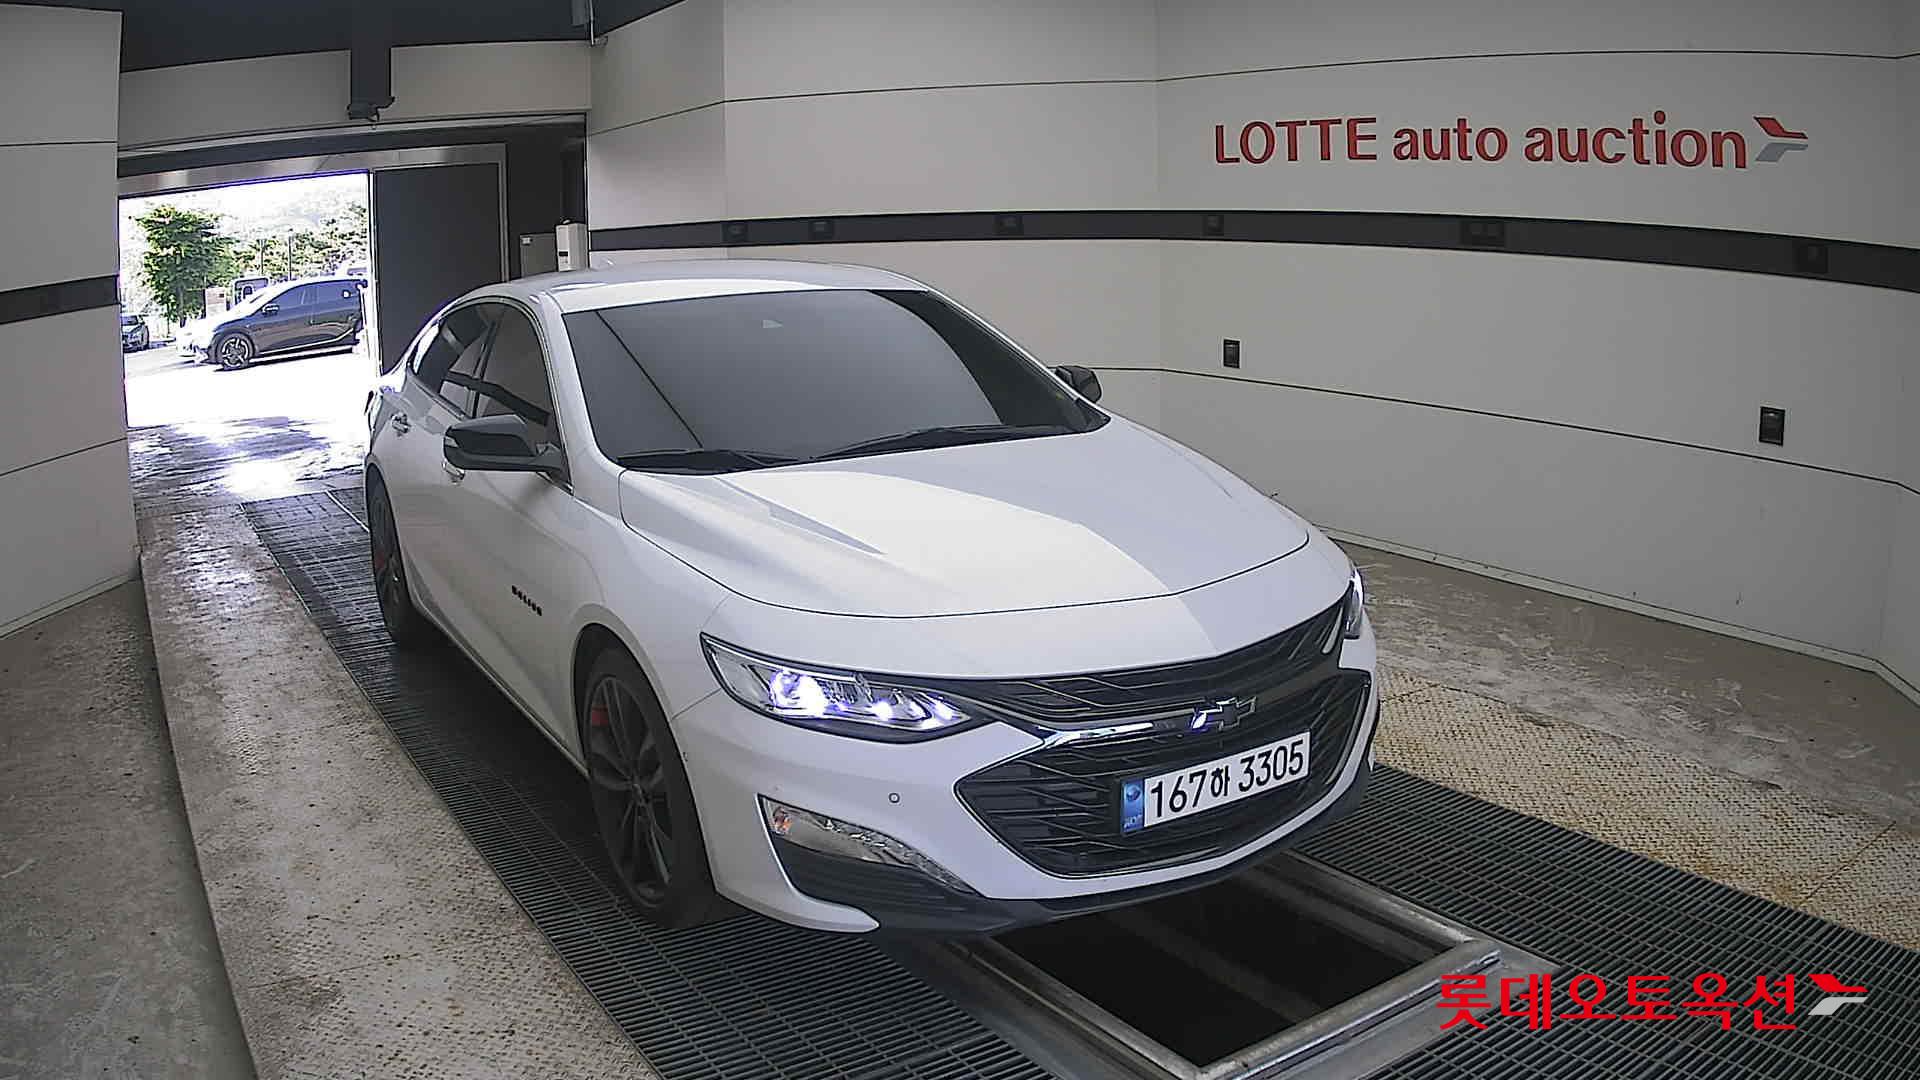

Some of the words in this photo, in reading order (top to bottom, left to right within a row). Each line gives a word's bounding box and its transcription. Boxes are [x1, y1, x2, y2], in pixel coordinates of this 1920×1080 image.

[1215, 117, 1377, 164] LOTTE
[1393, 118, 1508, 161] auto
[1523, 110, 1747, 168] auction
[1151, 765, 1231, 818] 167하
[1238, 740, 1304, 793] 3305
